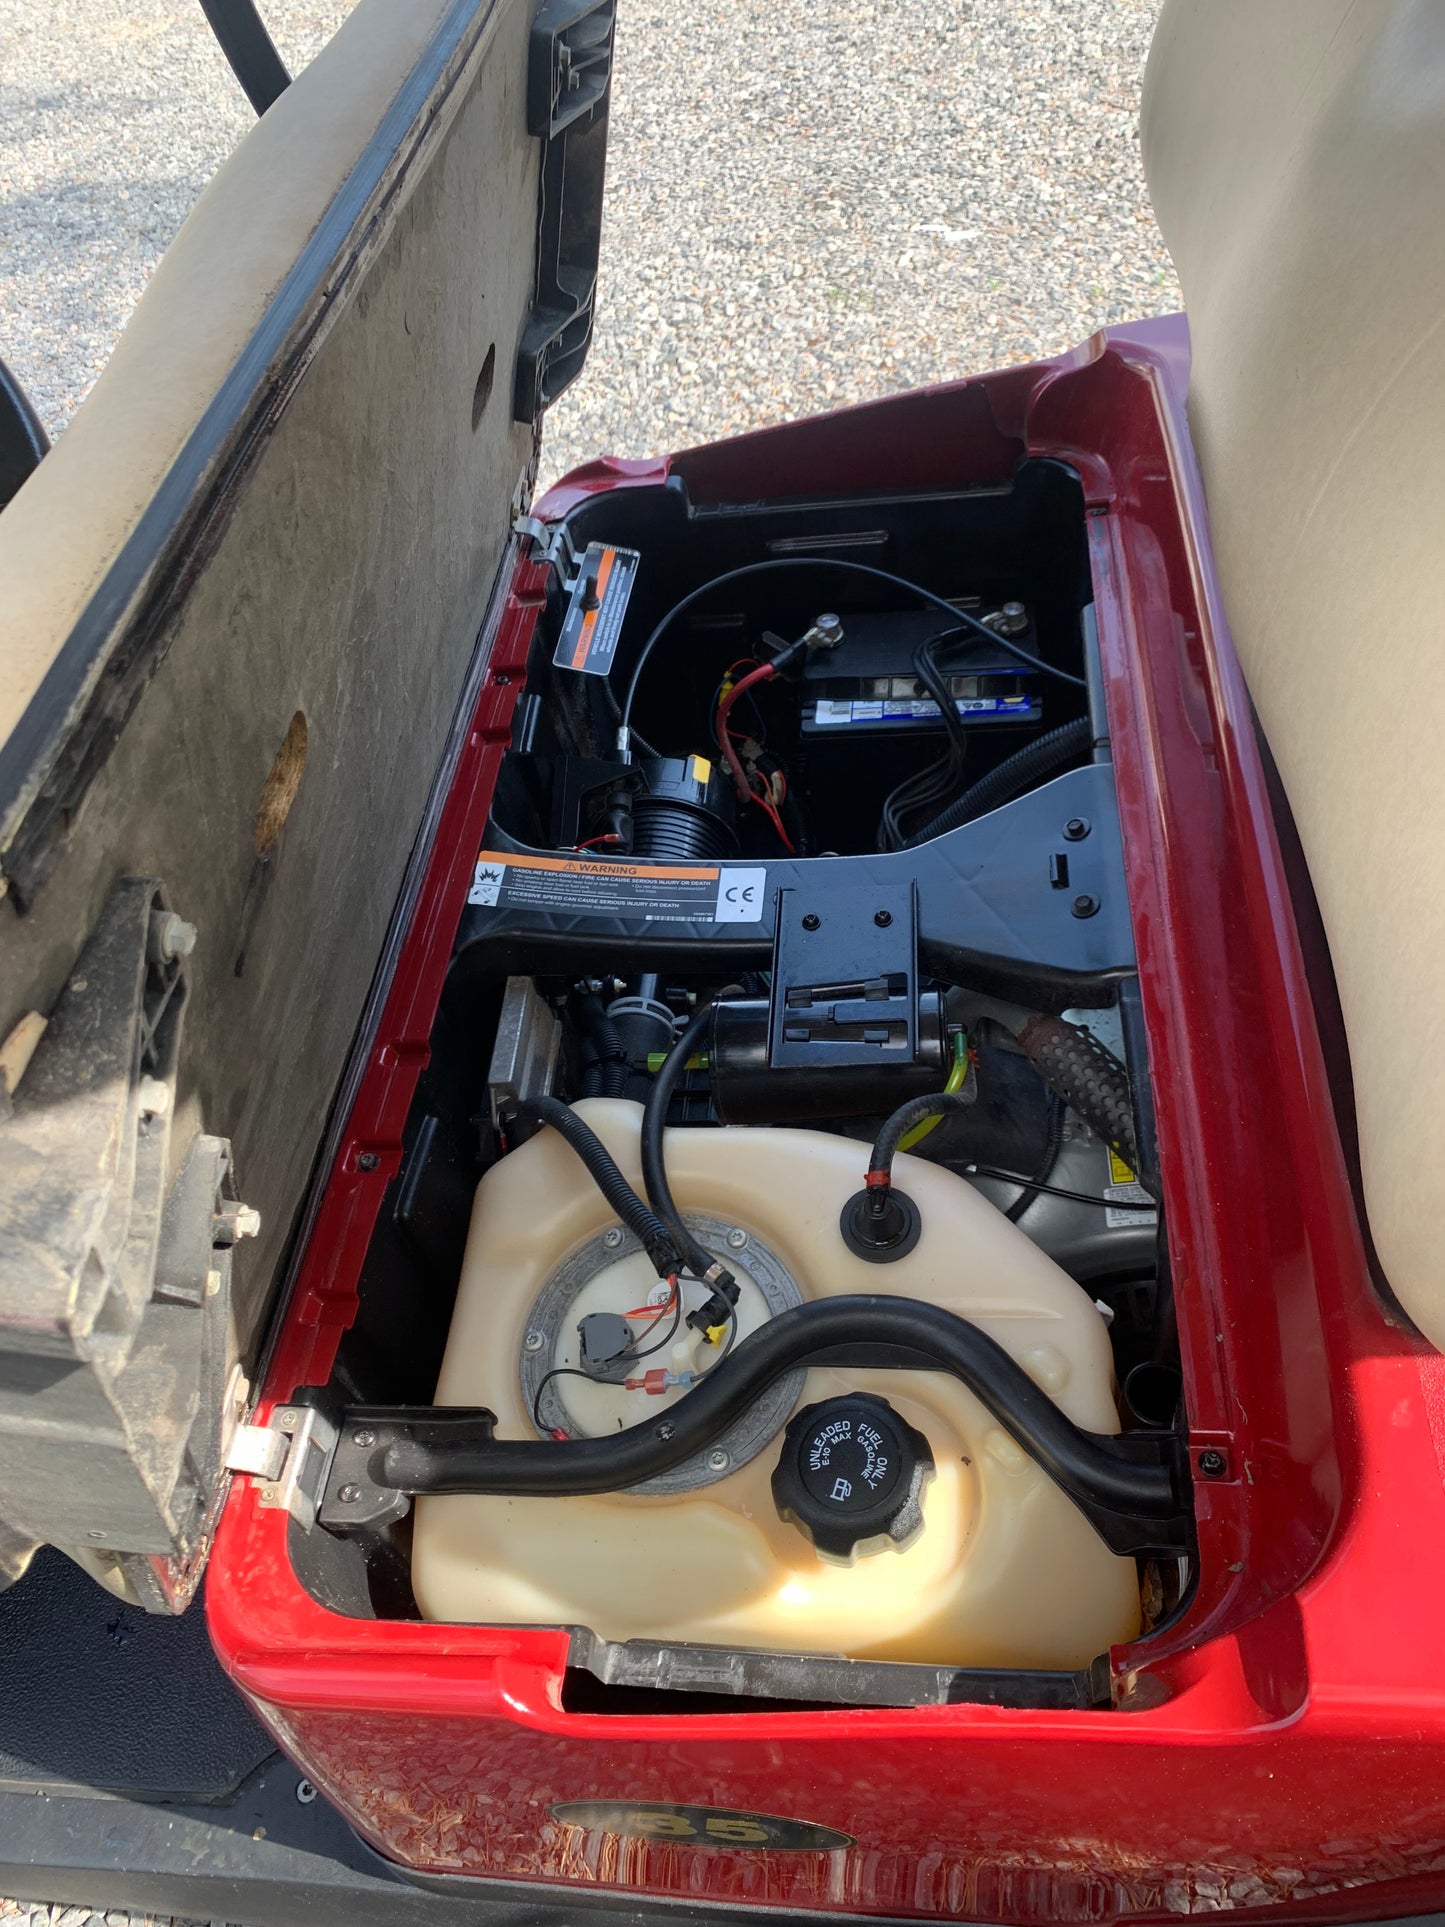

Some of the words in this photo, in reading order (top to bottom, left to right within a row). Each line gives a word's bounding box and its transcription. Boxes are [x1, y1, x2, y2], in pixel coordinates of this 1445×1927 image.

[579, 864, 637, 874] WARNING
[726, 886, 754, 902] CE
[810, 1420, 850, 1470] UNLEADED
[858, 1423, 883, 1450] FUEL
[822, 1447, 831, 1466] E-10
[830, 1432, 852, 1445] MAX
[857, 1435, 876, 1480] GASOLINE
[868, 1457, 888, 1490] ONLY
[632, 1811, 769, 1842] 35
